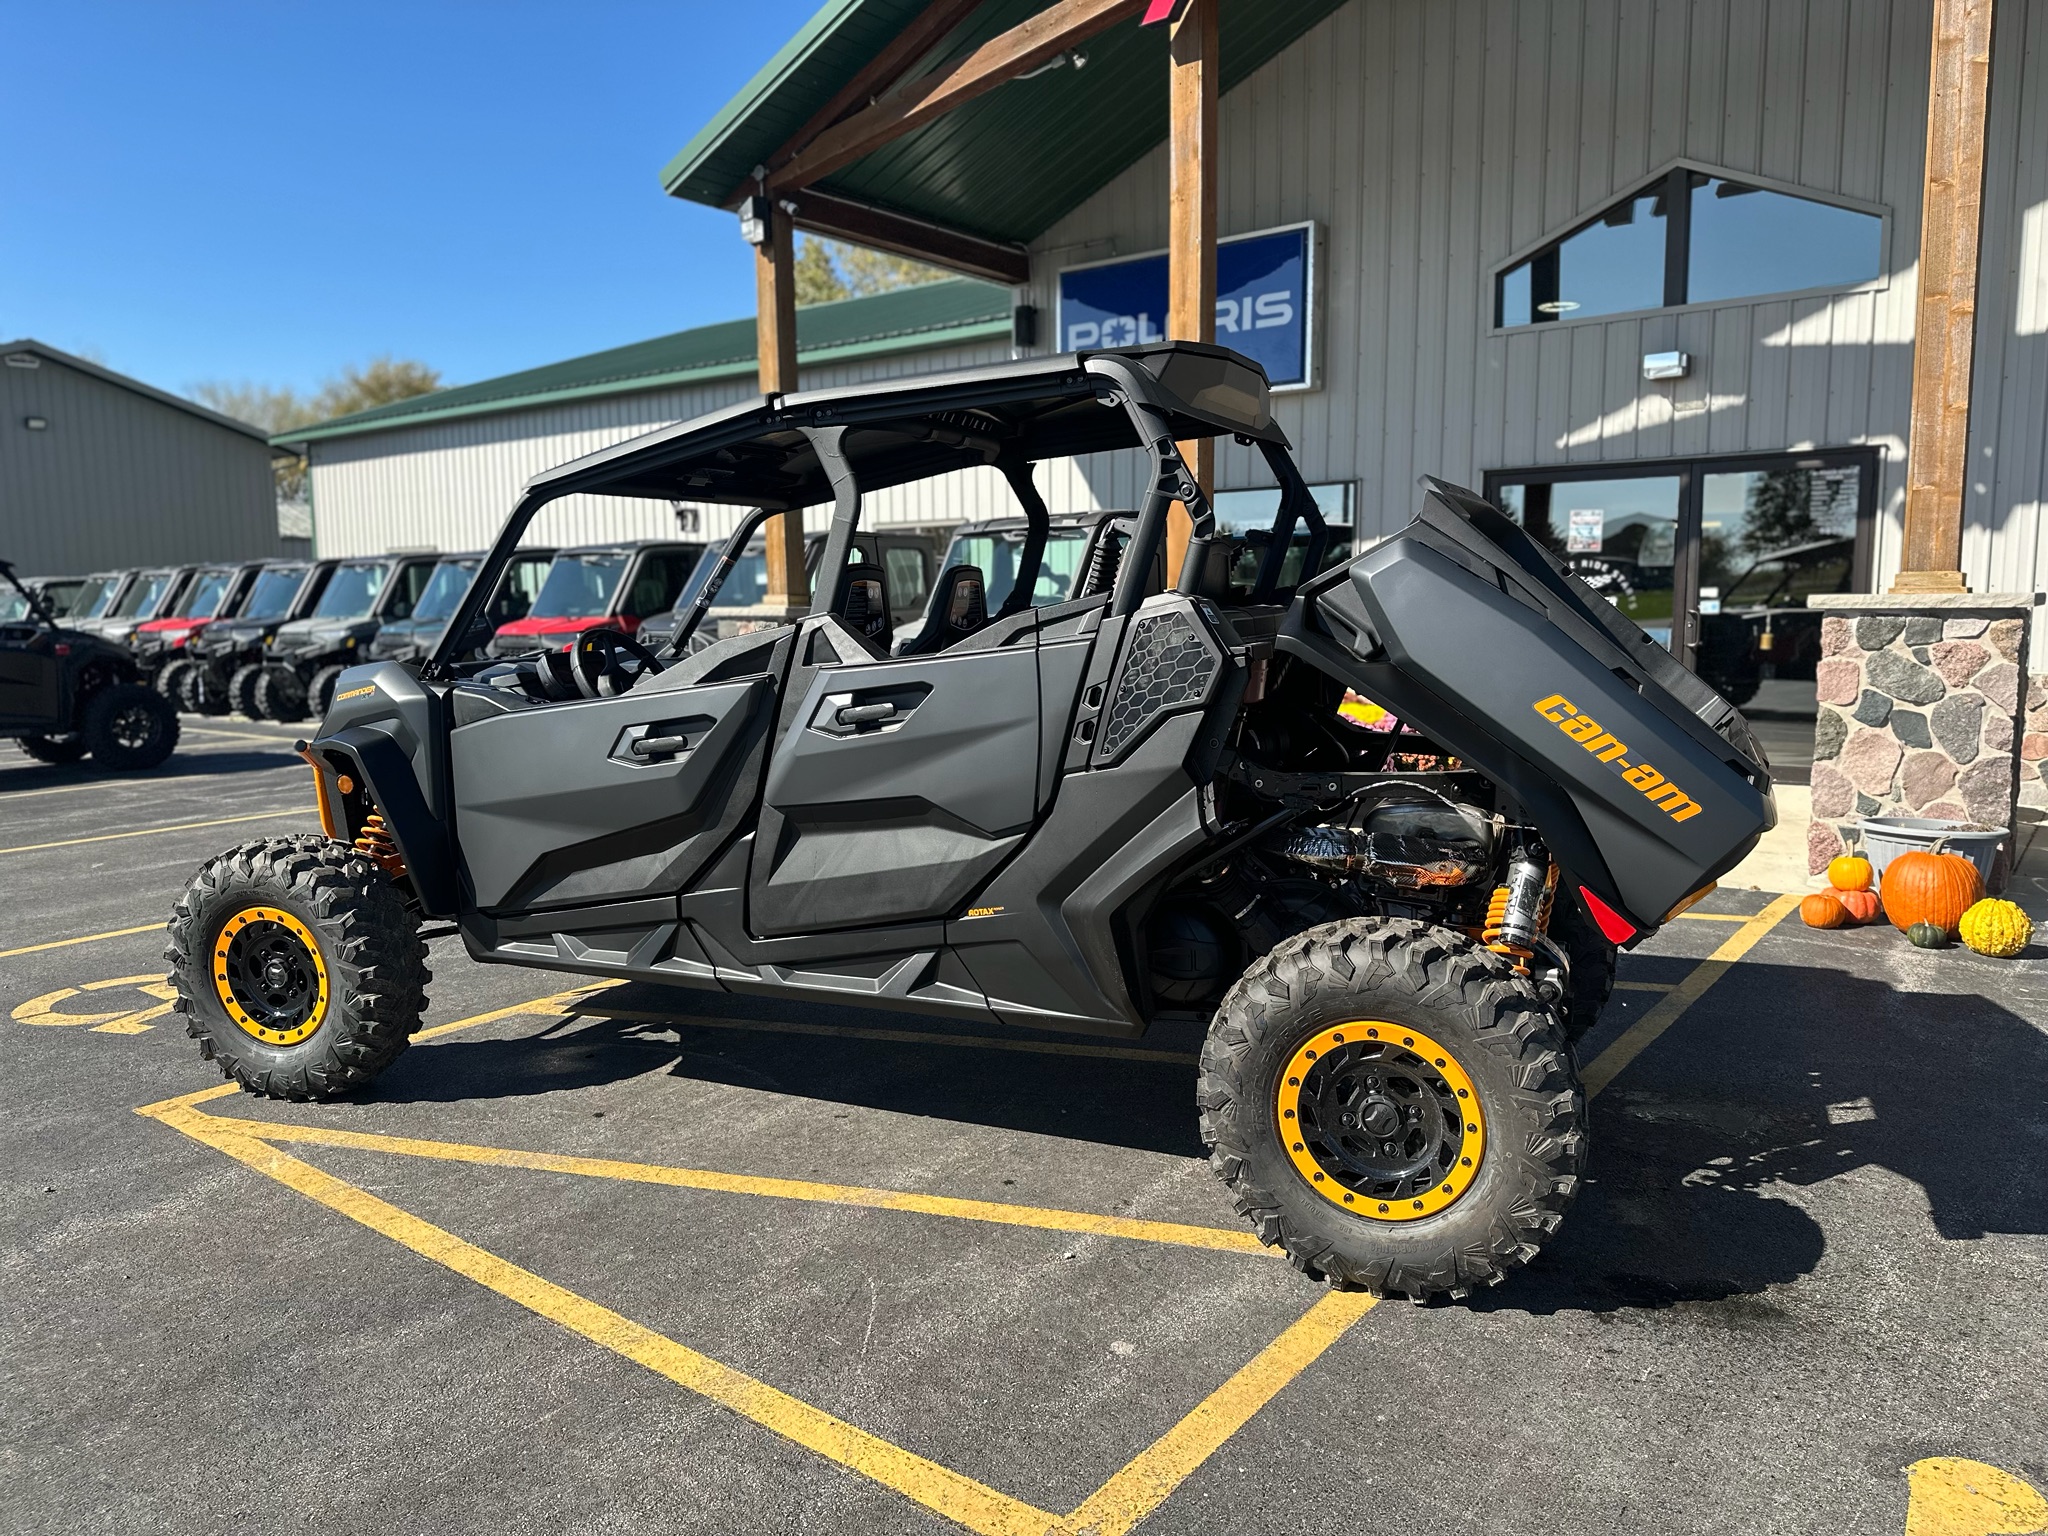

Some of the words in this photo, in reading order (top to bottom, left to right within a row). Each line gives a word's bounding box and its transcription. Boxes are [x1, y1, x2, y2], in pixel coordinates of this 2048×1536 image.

[1068, 290, 1294, 351] POLRIS
[337, 685, 376, 701] COMMANDER
[1533, 693, 1703, 823] can-am
[968, 908, 994, 916] ROTAX
